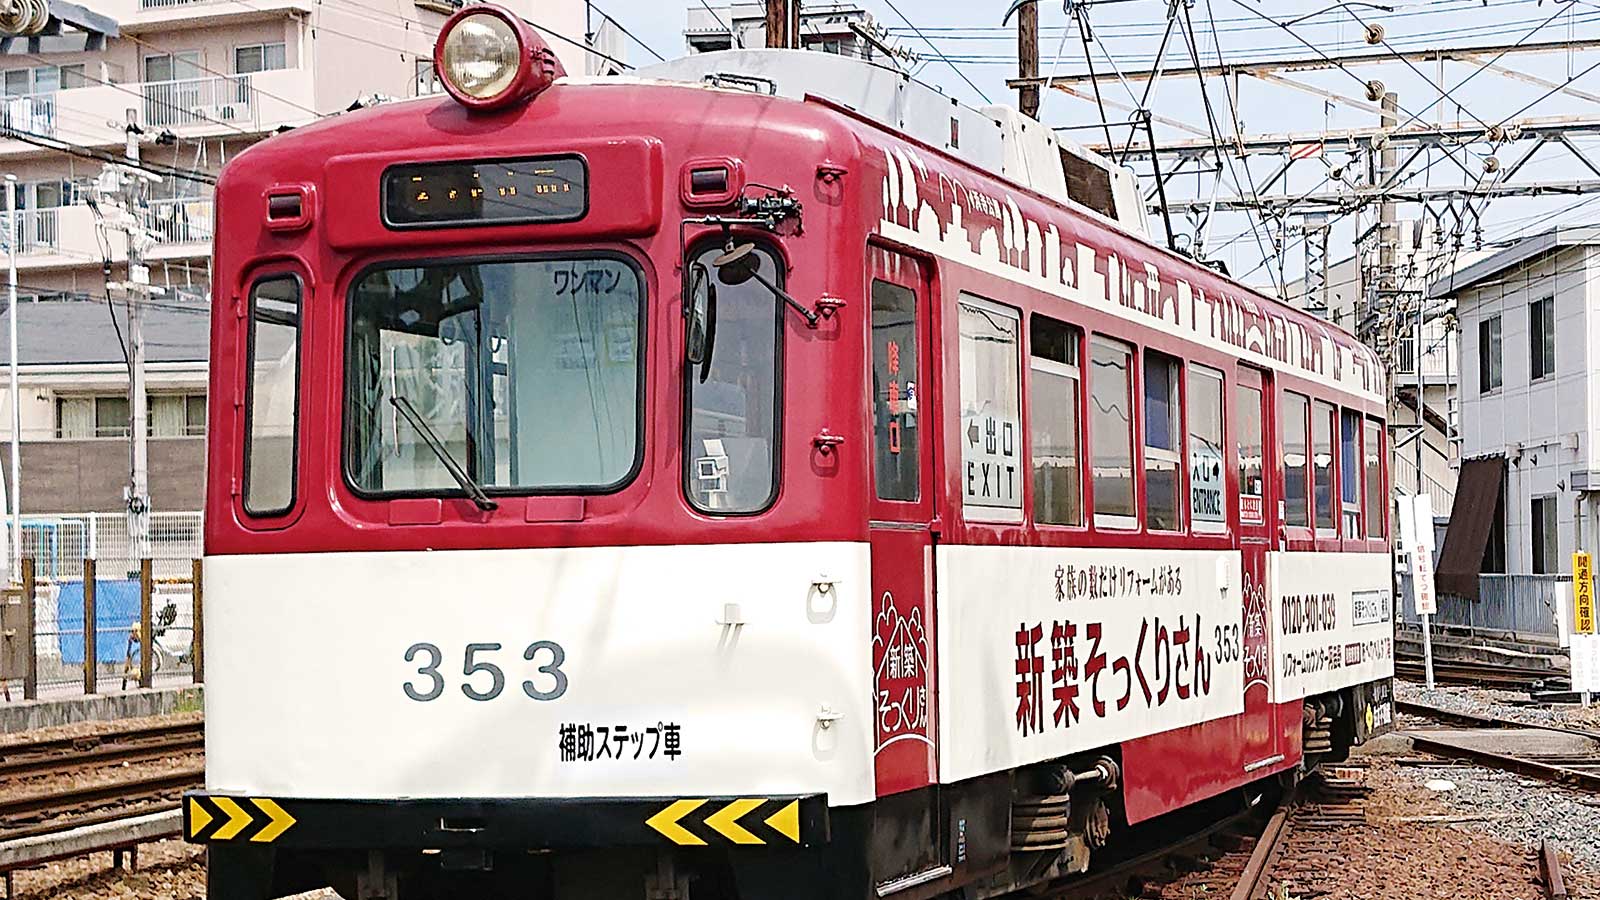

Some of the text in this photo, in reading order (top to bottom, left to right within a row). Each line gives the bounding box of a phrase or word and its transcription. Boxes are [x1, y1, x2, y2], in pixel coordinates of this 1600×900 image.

[554, 271, 621, 296] ワンマン
[986, 416, 1013, 457] 出口
[968, 461, 1015, 499] EXIT
[1193, 452, 1210, 482] 入口
[1192, 486, 1221, 515] ENTRANCE
[1577, 555, 1591, 631] 開通方向確認
[1214, 623, 1240, 665] 353
[403, 640, 569, 702] 353
[1015, 613, 1212, 738] 新築そっくりさん
[558, 721, 682, 762] 補助ステップ車
